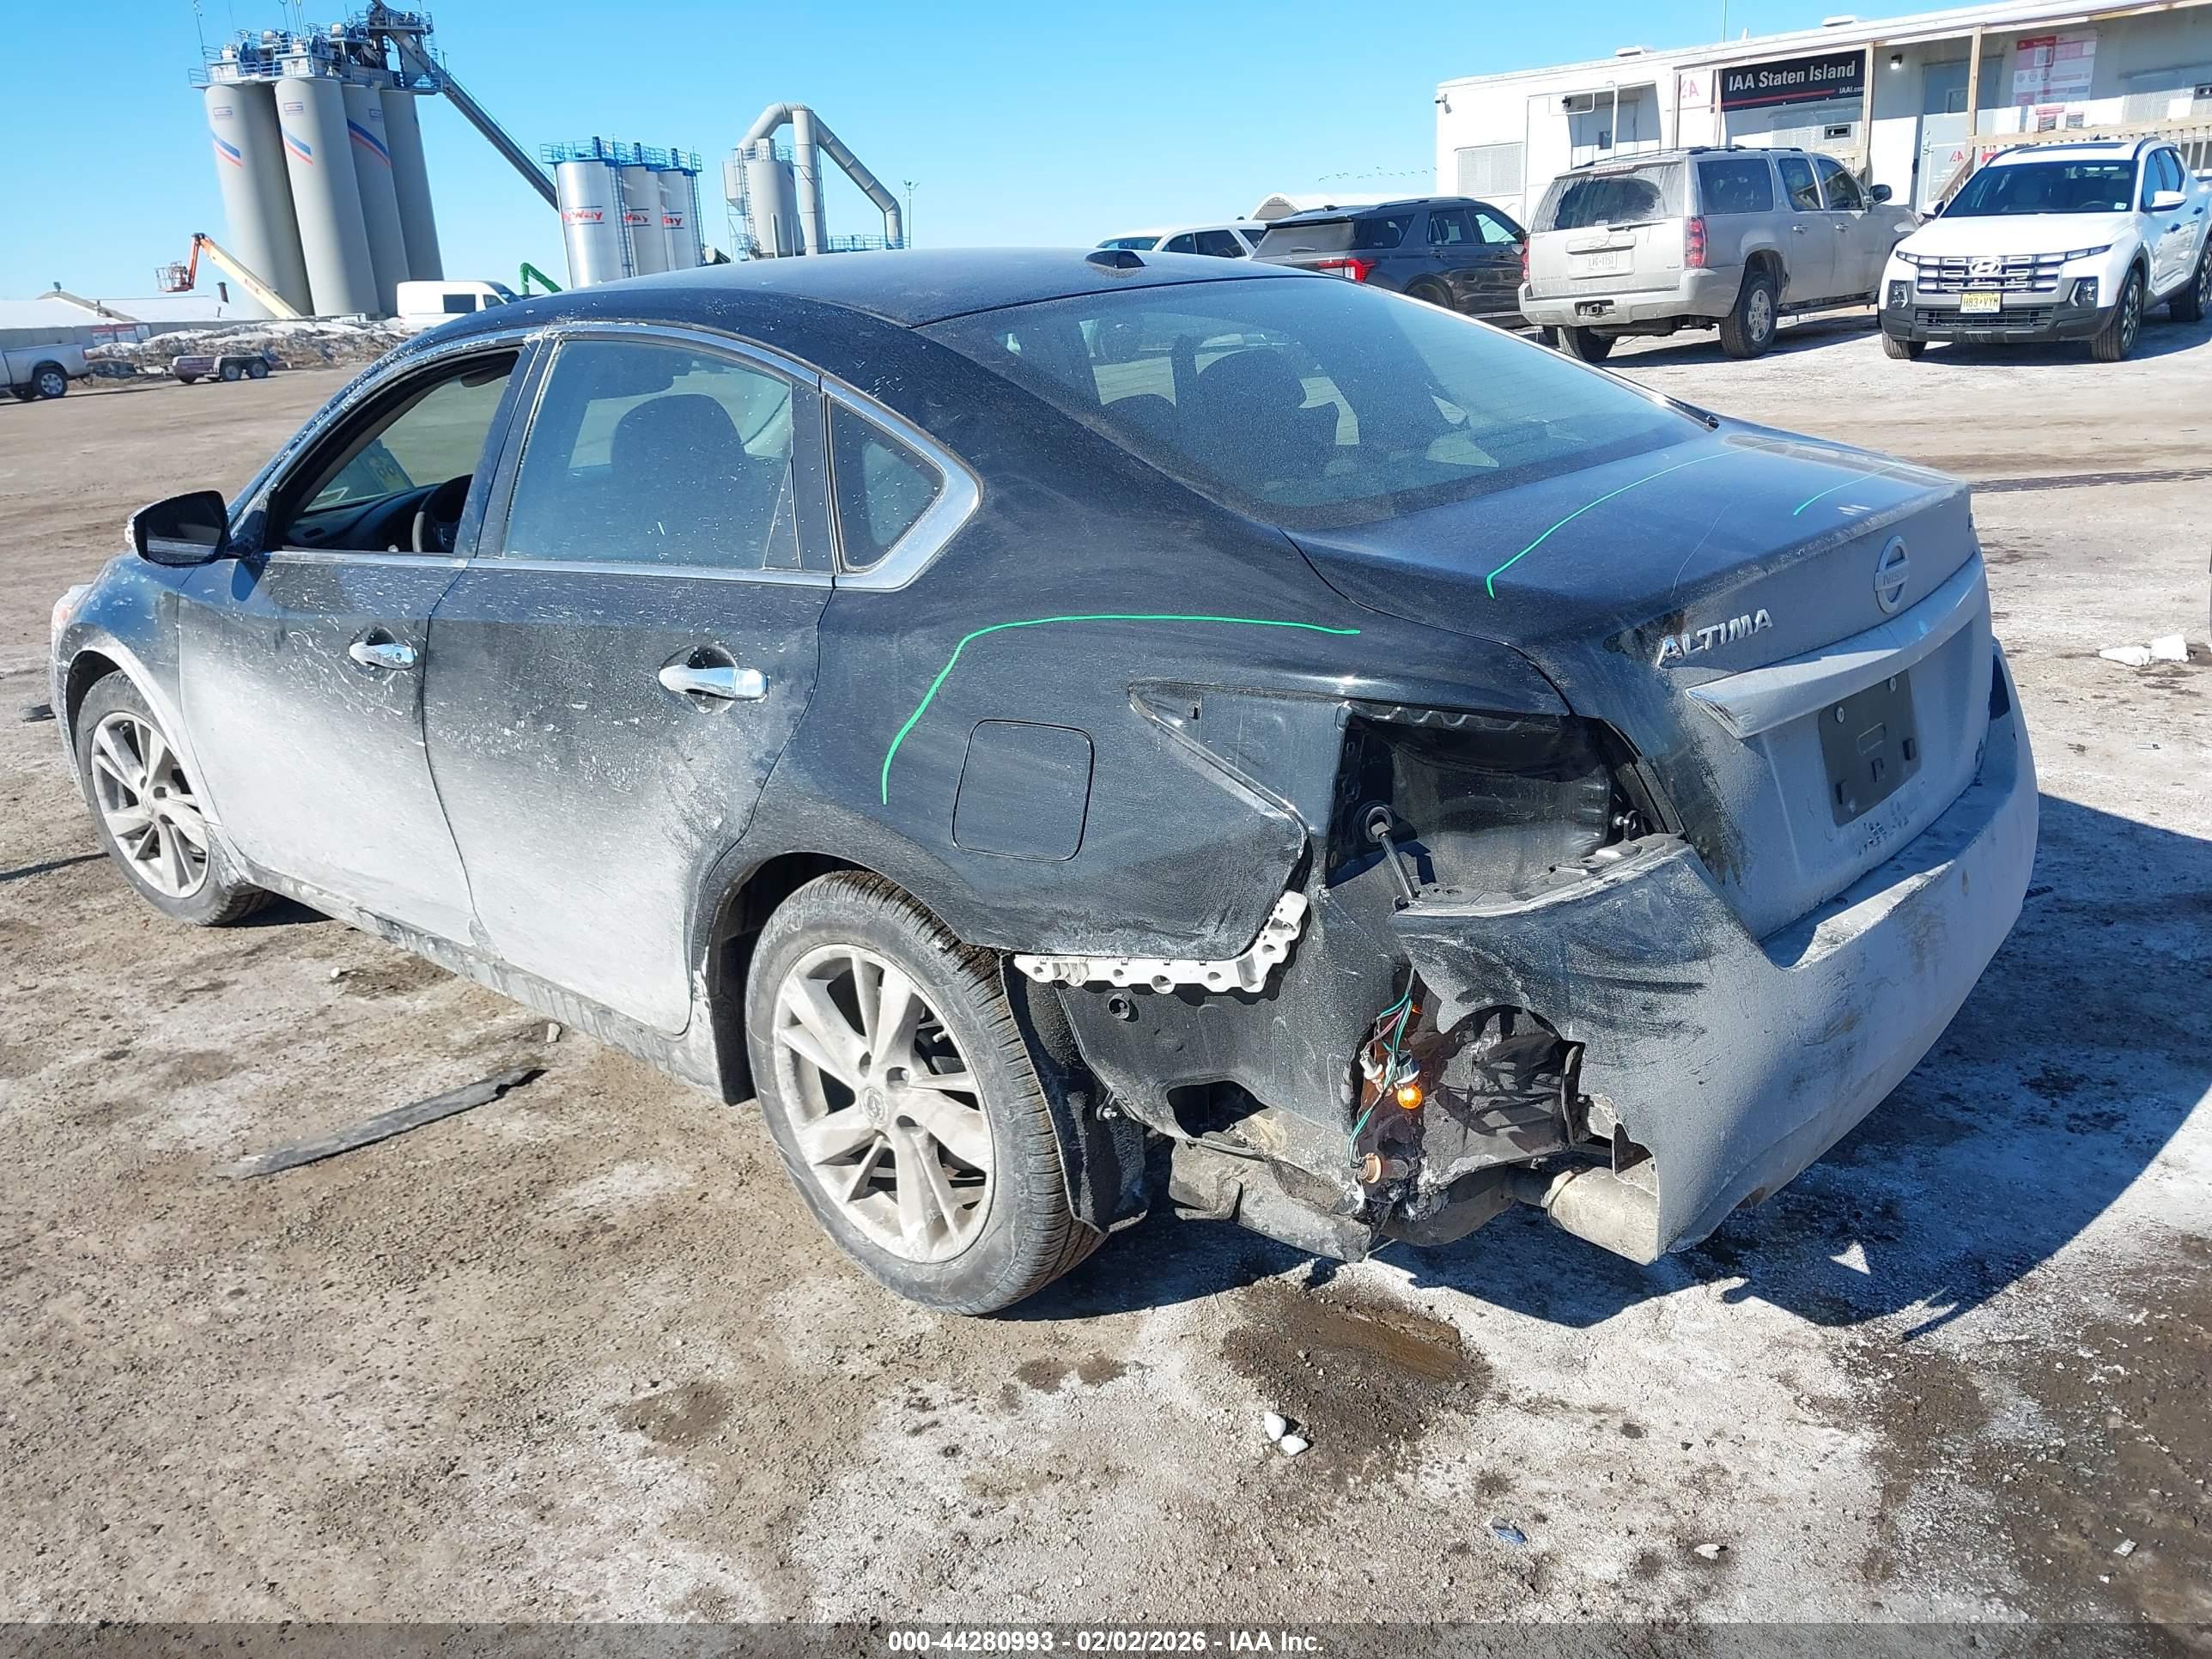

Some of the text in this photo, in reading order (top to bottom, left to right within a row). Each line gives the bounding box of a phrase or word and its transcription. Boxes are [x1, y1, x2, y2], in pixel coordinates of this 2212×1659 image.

[1728, 60, 1856, 92] IAA Staten Island
[1656, 608, 1773, 667] ALTIMA
